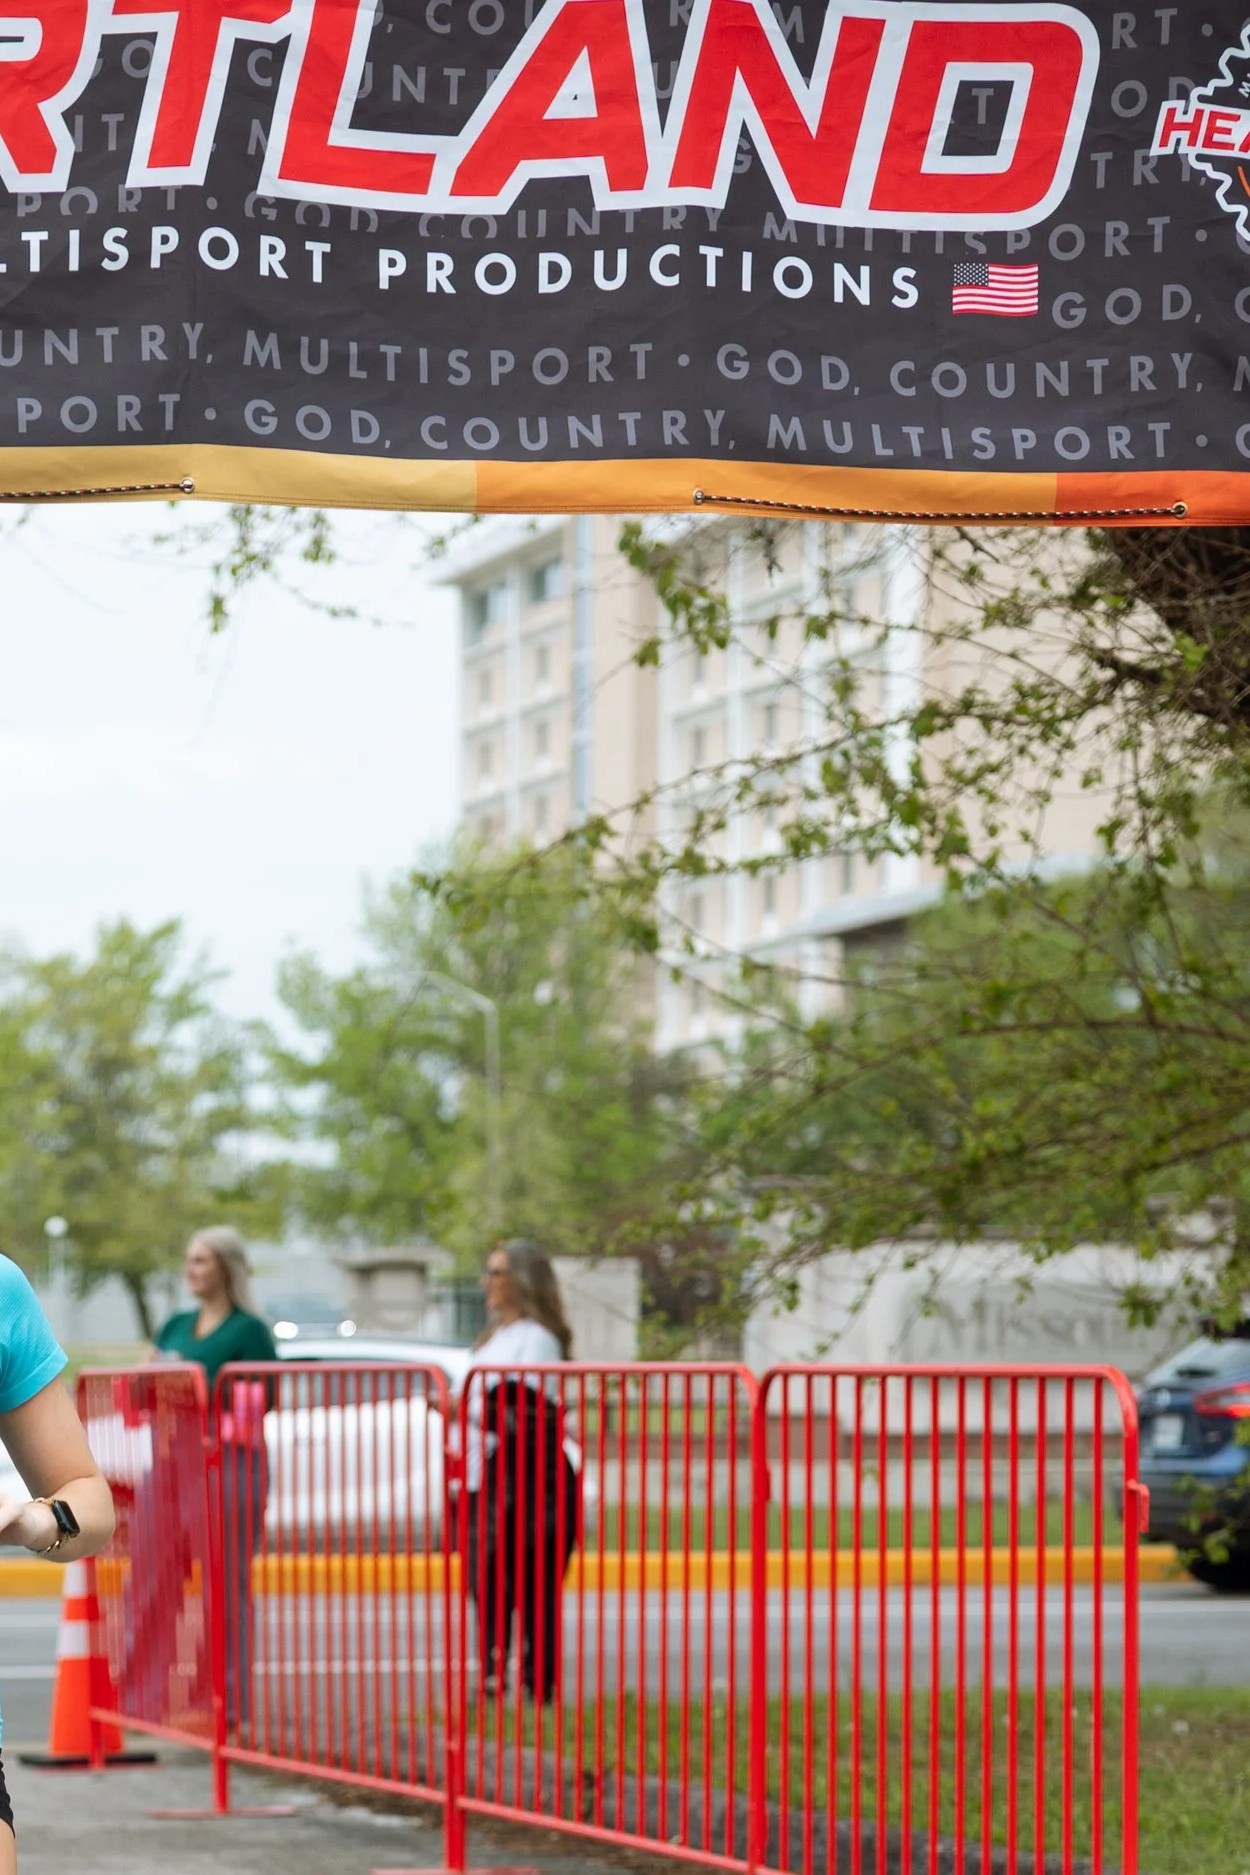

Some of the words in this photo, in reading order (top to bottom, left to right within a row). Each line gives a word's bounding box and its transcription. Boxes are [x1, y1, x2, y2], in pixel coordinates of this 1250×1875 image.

[378, 242, 919, 310] PRODUCTIONS
[1052, 283, 1203, 329] GOD,
[243, 329, 652, 388] MULTISPORT
[716, 342, 860, 396] GOD,
[890, 352, 1204, 399] COUNTRY,
[243, 398, 392, 451] GOD,
[421, 408, 735, 451] COUNTRY,
[767, 412, 1170, 463] MULTISPORT
